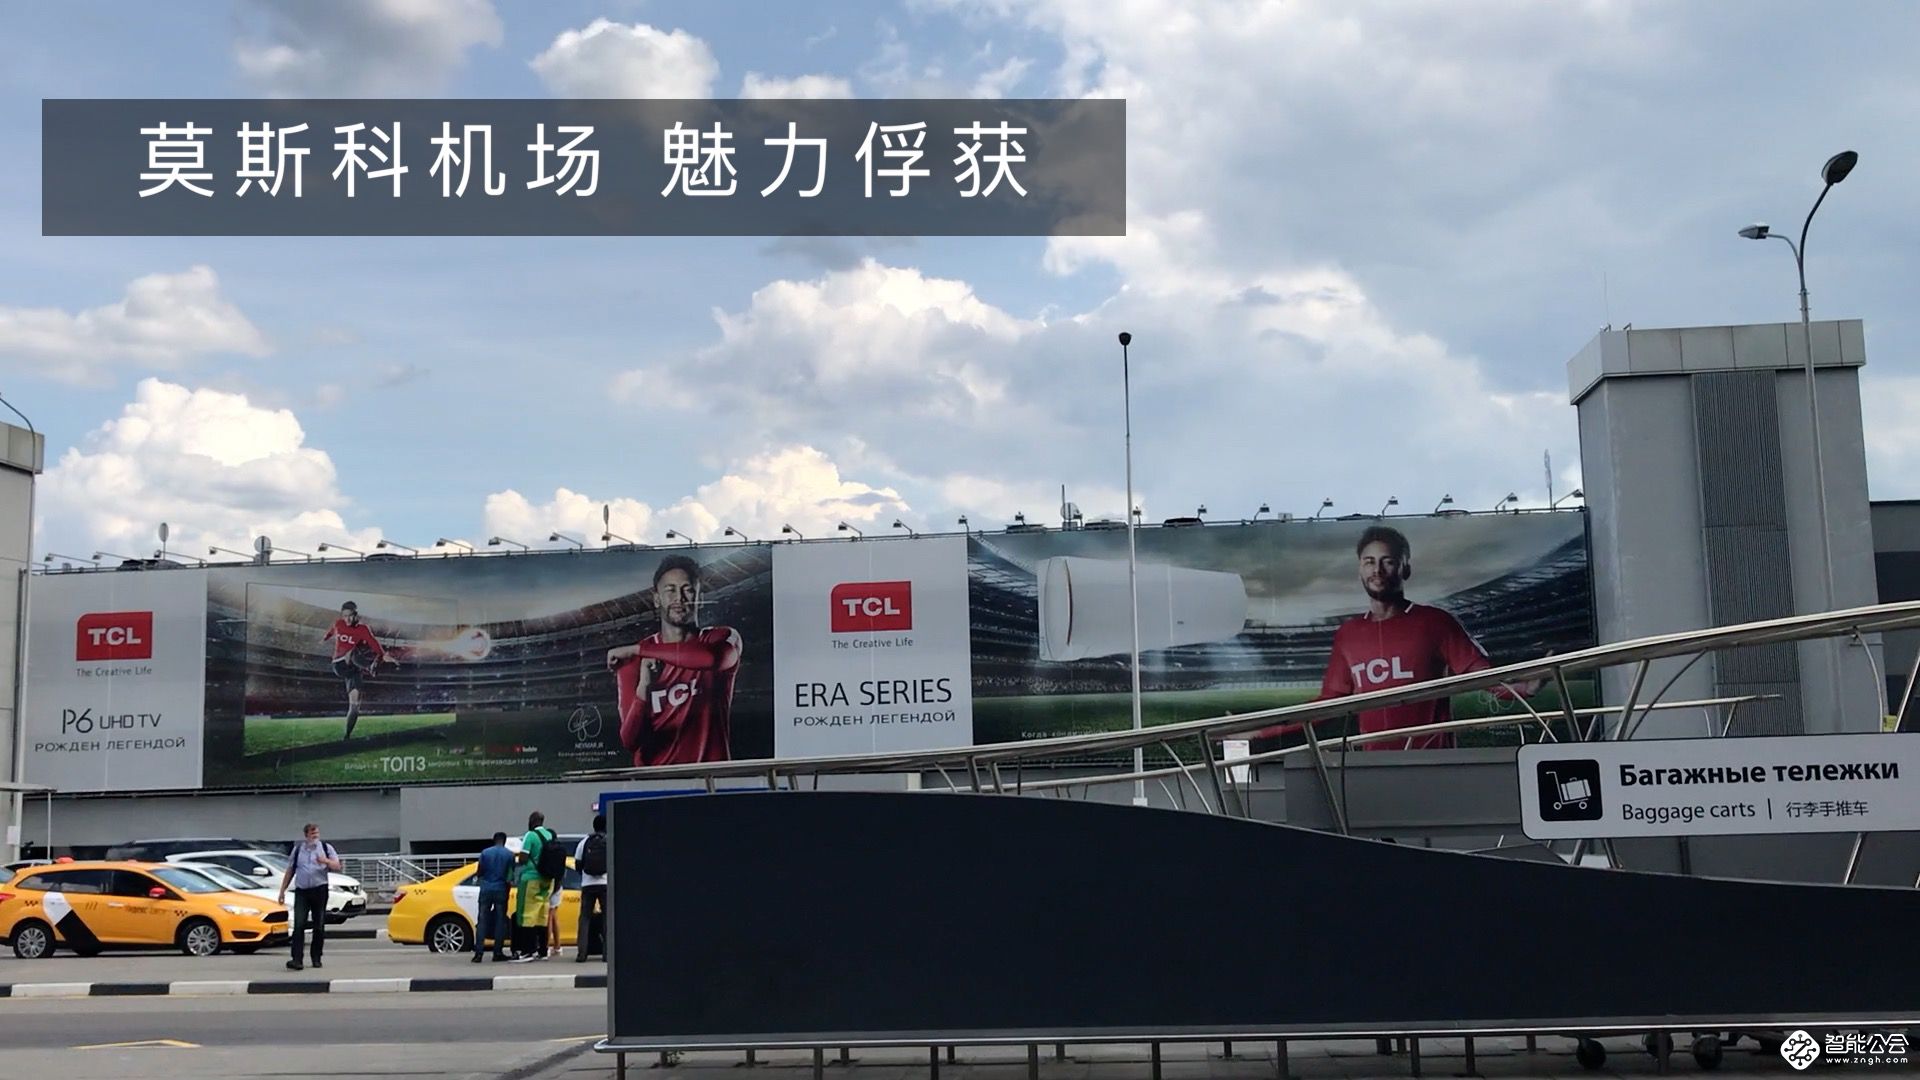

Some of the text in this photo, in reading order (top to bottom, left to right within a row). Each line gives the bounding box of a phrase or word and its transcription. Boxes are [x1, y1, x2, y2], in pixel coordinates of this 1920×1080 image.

[842, 597, 901, 617] TCL
[87, 627, 142, 646] TCL
[832, 637, 914, 649] The Creative Life
[76, 666, 152, 677] The Creative Life
[1350, 656, 1414, 688] TCL
[795, 678, 952, 708] ERA SERIES
[62, 708, 162, 734] P6 UHD TV
[793, 709, 956, 727] РОЖДЕН ЛЕГЕНДОЙ
[35, 736, 186, 753] РОЖДЕН ЛЕГЕНДОЙ
[380, 756, 426, 773] ТОП3
[1619, 762, 1900, 787] Багажные тележки
[1622, 800, 1870, 824] Baggage carts 行李手推车
